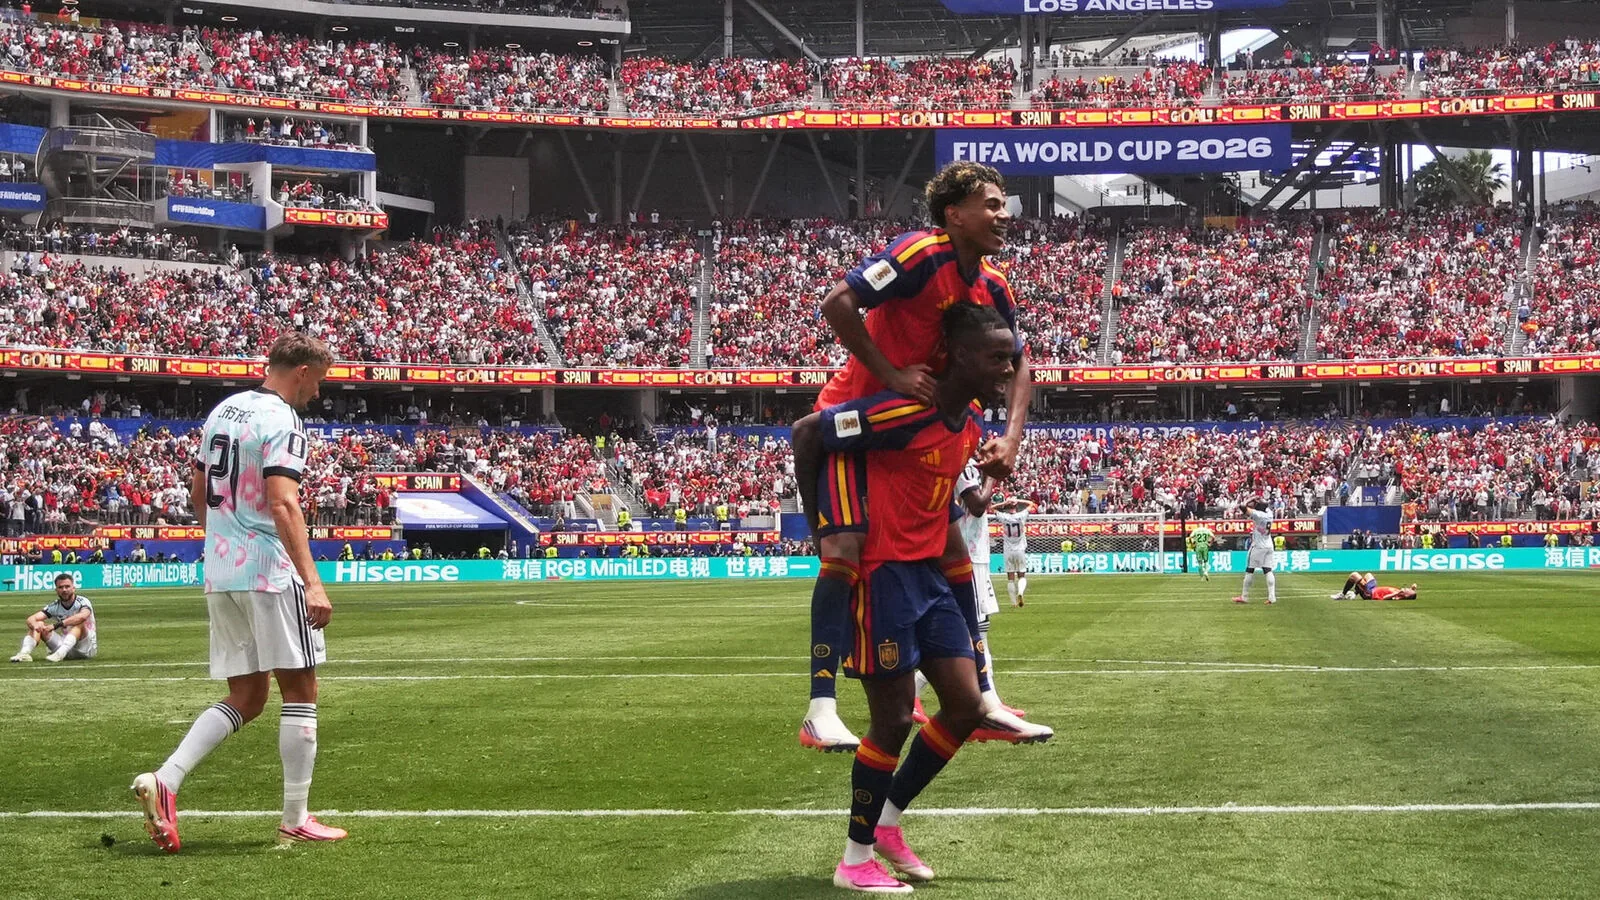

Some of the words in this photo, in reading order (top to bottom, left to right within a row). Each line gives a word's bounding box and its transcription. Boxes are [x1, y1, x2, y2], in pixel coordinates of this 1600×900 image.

[1024, 0, 1079, 12] LOS
[1085, 0, 1214, 11] ANGELES
[34, 76, 51, 86] SPAIN
[153, 88, 171, 98] SPAIN
[300, 101, 316, 111] SPAIN
[1441, 98, 1484, 114] GOAL!
[1562, 94, 1595, 108] SPAIN
[442, 110, 460, 120] SPAIN
[1170, 108, 1213, 123] GOAL!
[1289, 105, 1322, 120] SPAIN
[583, 116, 600, 126] SPAIN
[721, 120, 738, 128] SPAIN
[902, 112, 944, 126] GOAL!
[1020, 112, 1052, 126] SPAIN
[953, 142, 1011, 162] FIFA
[1014, 141, 1112, 162] WORLD
[1118, 140, 1172, 161] CUP
[1177, 138, 1272, 160] 2026
[336, 214, 371, 226] GOAL!
[22, 352, 62, 368] GOAL!
[132, 358, 159, 372] SPAIN
[1504, 360, 1532, 372] SPAIN
[373, 368, 400, 380] SPAIN
[1164, 368, 1202, 381] GOAL!
[1268, 366, 1295, 378] SPAIN
[1400, 363, 1436, 375] GOAL!
[456, 370, 494, 382] GOAL!
[564, 371, 591, 384] SPAIN
[696, 372, 732, 384] GOAL!
[800, 372, 827, 384] SPAIN
[1034, 370, 1062, 382] SPAIN
[1051, 428, 1106, 440] WORD
[207, 434, 240, 512] 21
[414, 476, 442, 490] SPAIN
[1006, 523, 1020, 538] 17
[1118, 524, 1138, 534] SPAIN
[1216, 522, 1244, 532] GOAL!
[1294, 522, 1315, 531] SPAIN
[1519, 523, 1548, 533] GOAL!
[136, 528, 154, 538] SPAIN
[557, 534, 578, 544] SPAIN
[658, 534, 686, 544] GOAL!
[736, 532, 758, 543] SPAIN
[1197, 533, 1208, 543] 23
[1271, 551, 1332, 571] 界第一
[1380, 550, 1505, 570] Hisense
[335, 562, 459, 582] Hisense
[591, 559, 668, 576] MiniLED
[726, 558, 810, 577] 世界第一
[15, 565, 82, 590] Hisee
